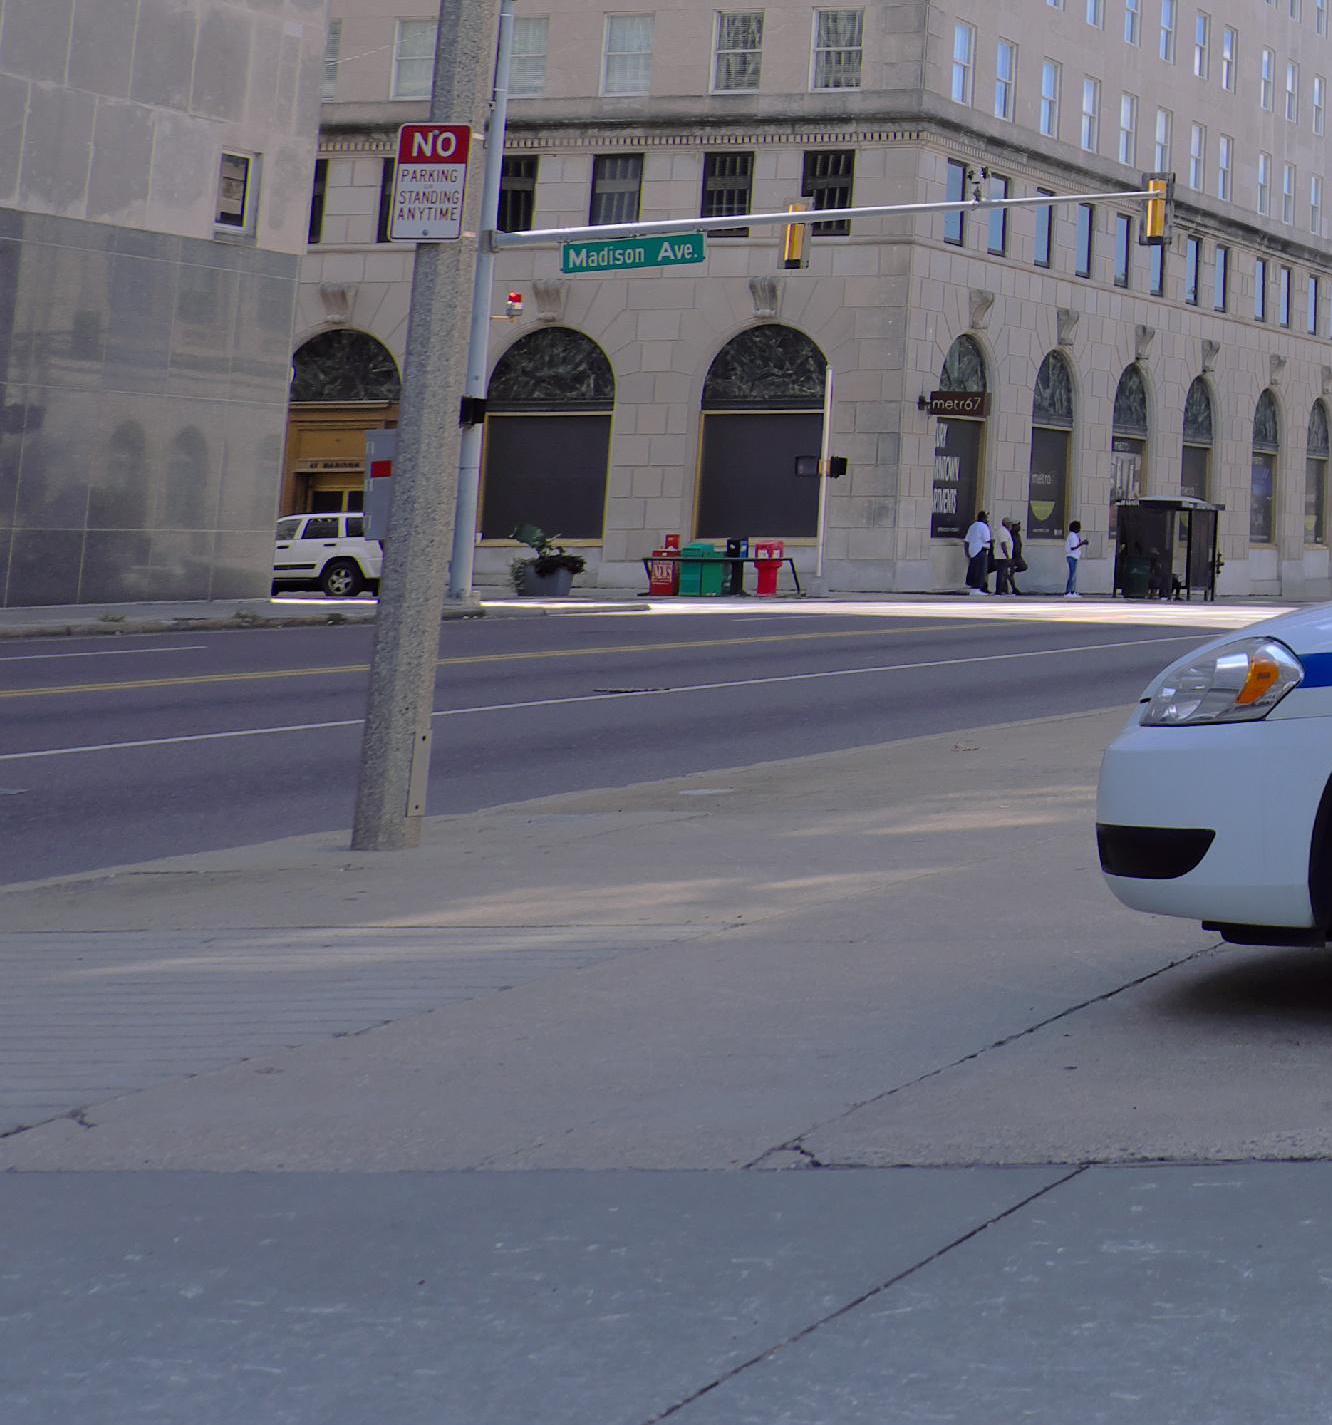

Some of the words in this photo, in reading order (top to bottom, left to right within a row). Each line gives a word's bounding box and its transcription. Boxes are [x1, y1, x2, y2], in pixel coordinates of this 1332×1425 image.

[411, 131, 457, 157] NO
[401, 168, 459, 183] PARKING
[399, 190, 460, 205] STANDING
[397, 206, 458, 221] ANYTIME
[568, 246, 645, 268] Madison
[657, 241, 698, 261] Ave.
